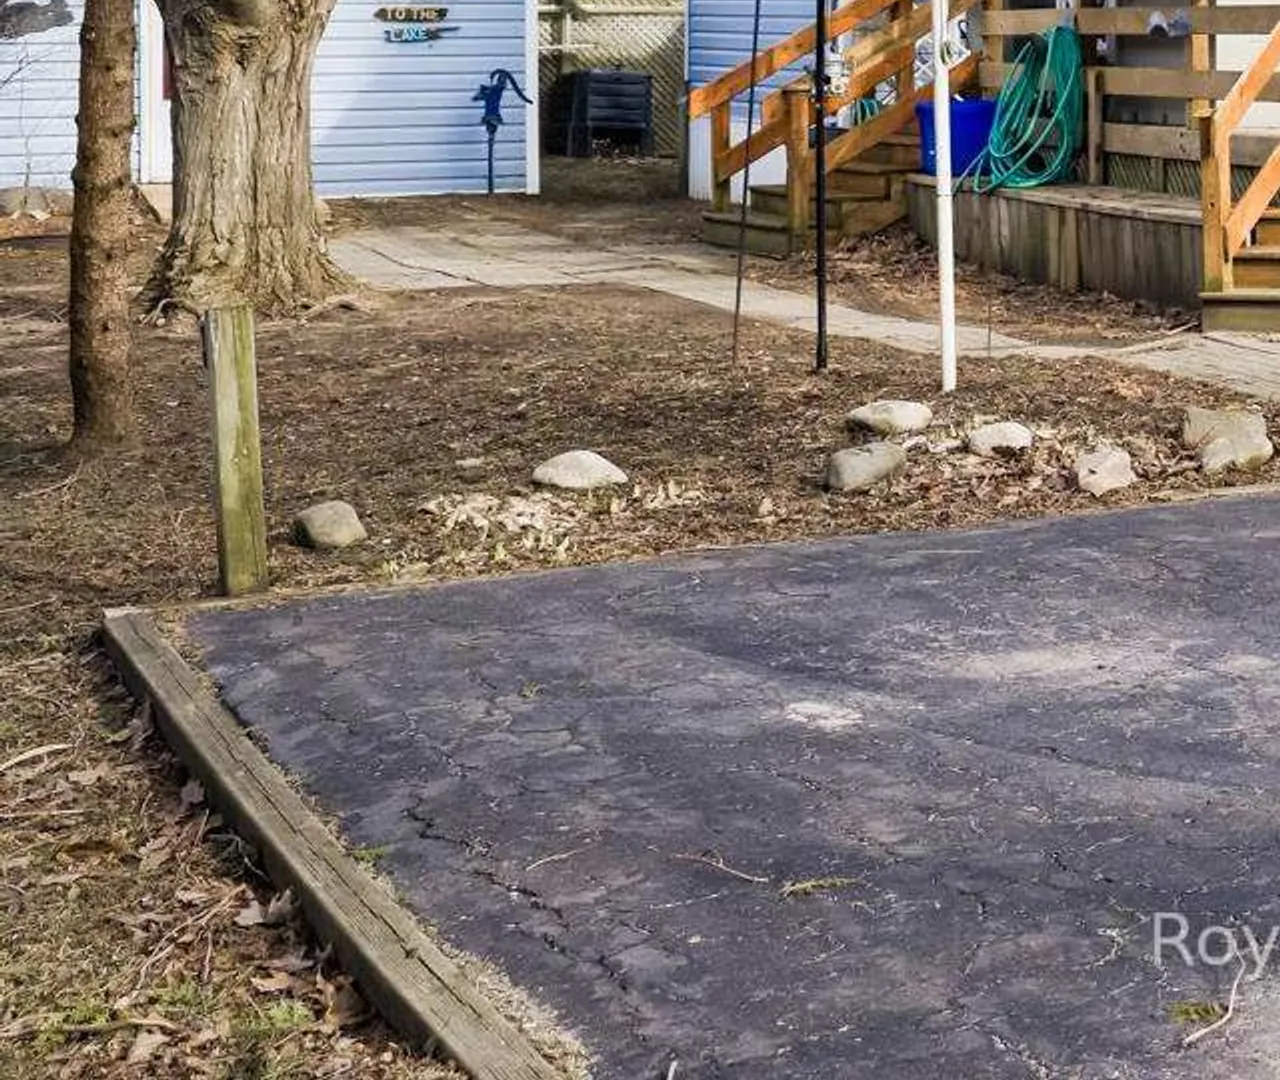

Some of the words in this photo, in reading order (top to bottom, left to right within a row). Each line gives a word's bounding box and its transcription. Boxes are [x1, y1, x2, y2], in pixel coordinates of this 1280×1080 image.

[386, 9, 405, 19] TO
[411, 9, 438, 19] THE
[389, 28, 429, 41] LAKE
